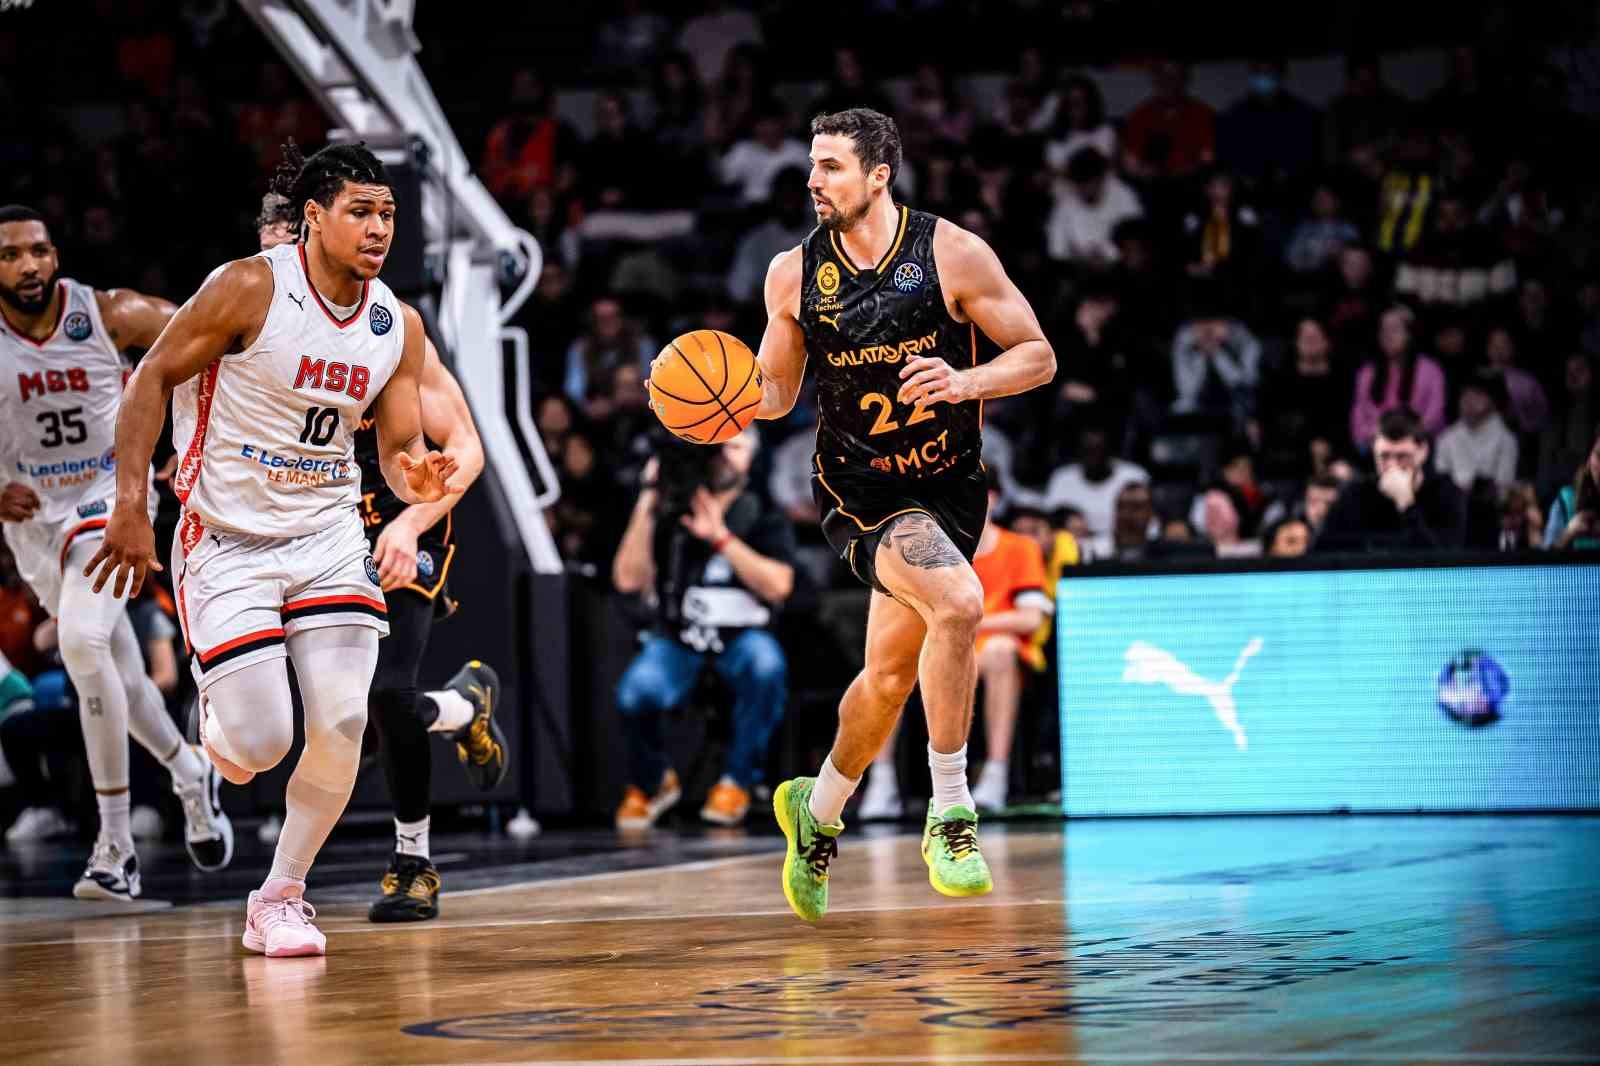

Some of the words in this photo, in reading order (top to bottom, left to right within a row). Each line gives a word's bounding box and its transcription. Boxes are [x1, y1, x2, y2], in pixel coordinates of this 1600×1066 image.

[814, 303, 846, 312] Technic
[827, 331, 937, 367] GALATASARAY
[293, 354, 371, 401] MSB
[36, 406, 88, 448] 35
[299, 406, 340, 446] 10
[240, 443, 331, 472] E.Leclerc
[895, 429, 949, 474] MCT
[267, 469, 283, 482] LE
[287, 470, 329, 487] MANS
[1115, 955, 1413, 992] LEAGUE
